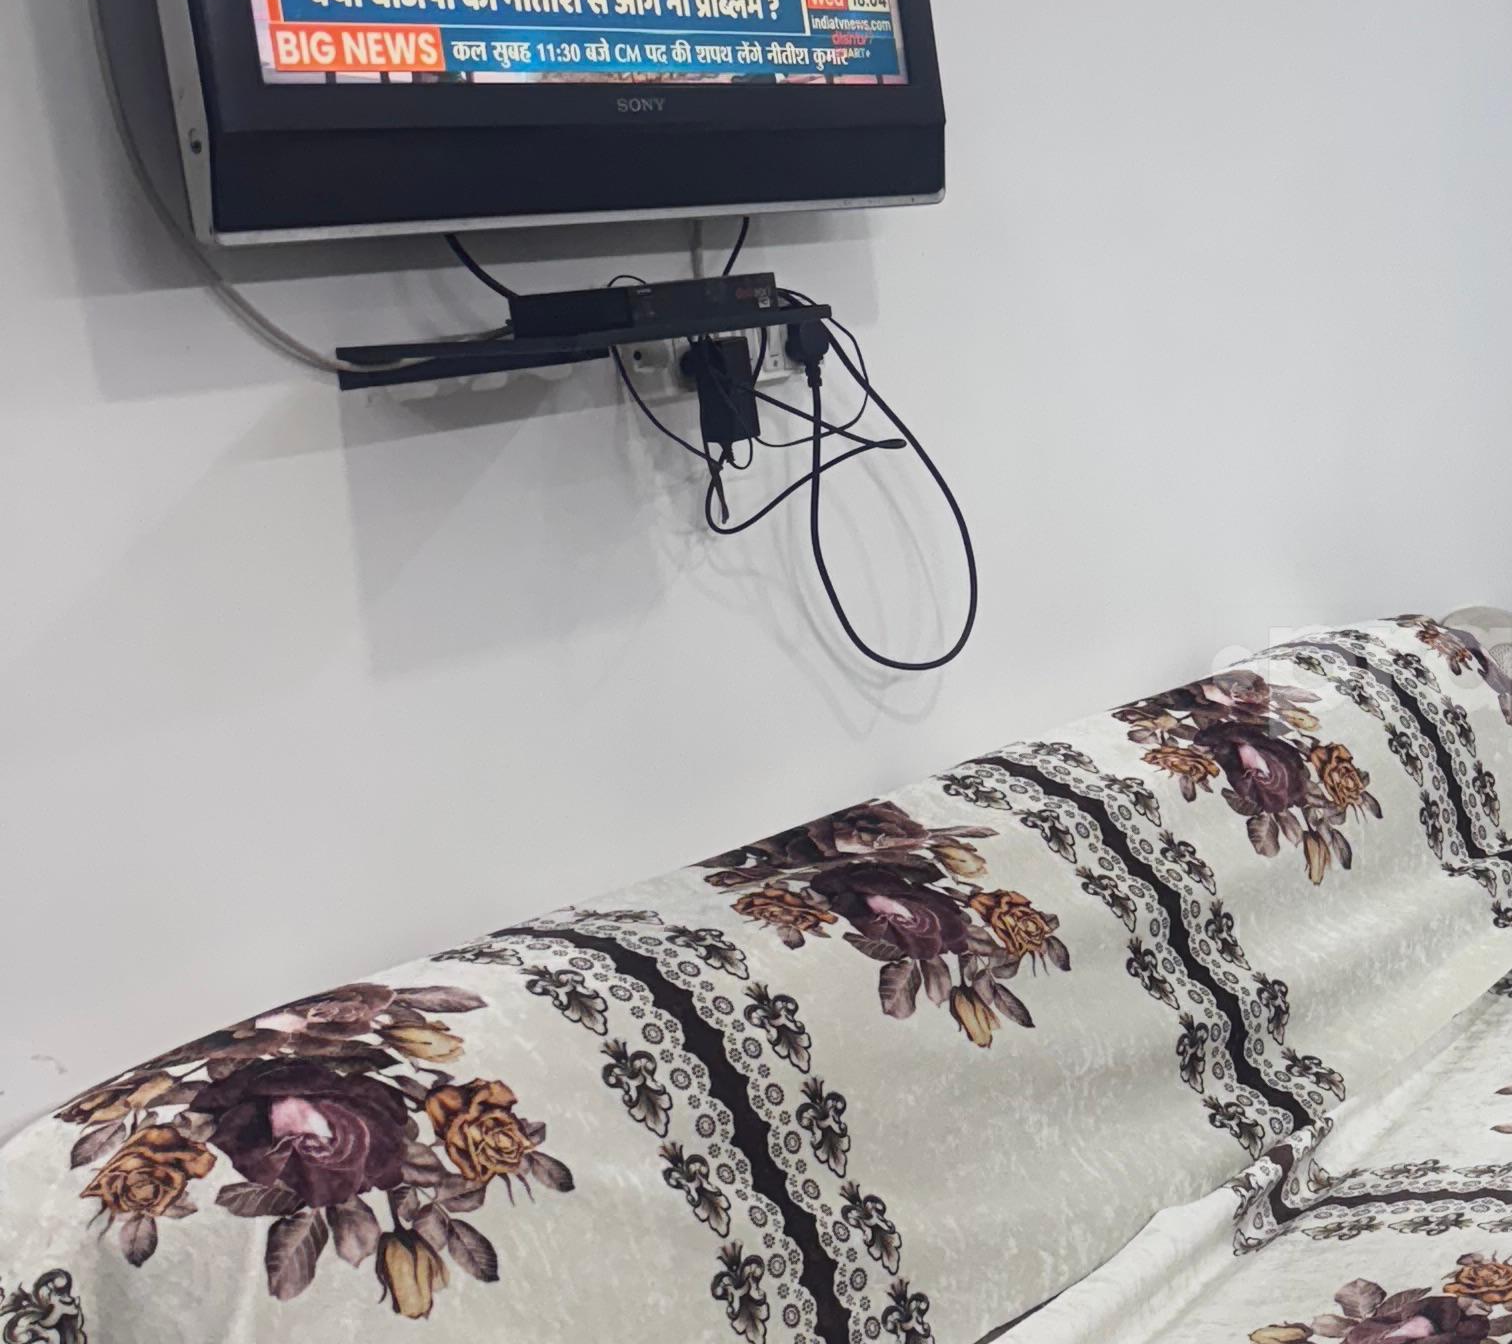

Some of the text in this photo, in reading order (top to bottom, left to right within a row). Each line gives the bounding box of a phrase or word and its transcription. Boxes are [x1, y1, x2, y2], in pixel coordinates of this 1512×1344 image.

[811, 14, 892, 32] indiatvnews.com
[275, 30, 438, 65] BIG NEWS
[451, 40, 487, 62] कल
[491, 41, 532, 68] सुबह
[536, 43, 581, 63] 11:30
[584, 38, 611, 63] बजे
[614, 44, 642, 63] CM
[644, 44, 667, 64] पद
[670, 39, 692, 64] की
[696, 44, 733, 64] शपथ
[736, 41, 763, 64] लेंगे
[765, 41, 808, 65] नीतीश
[616, 98, 666, 113] SONY
